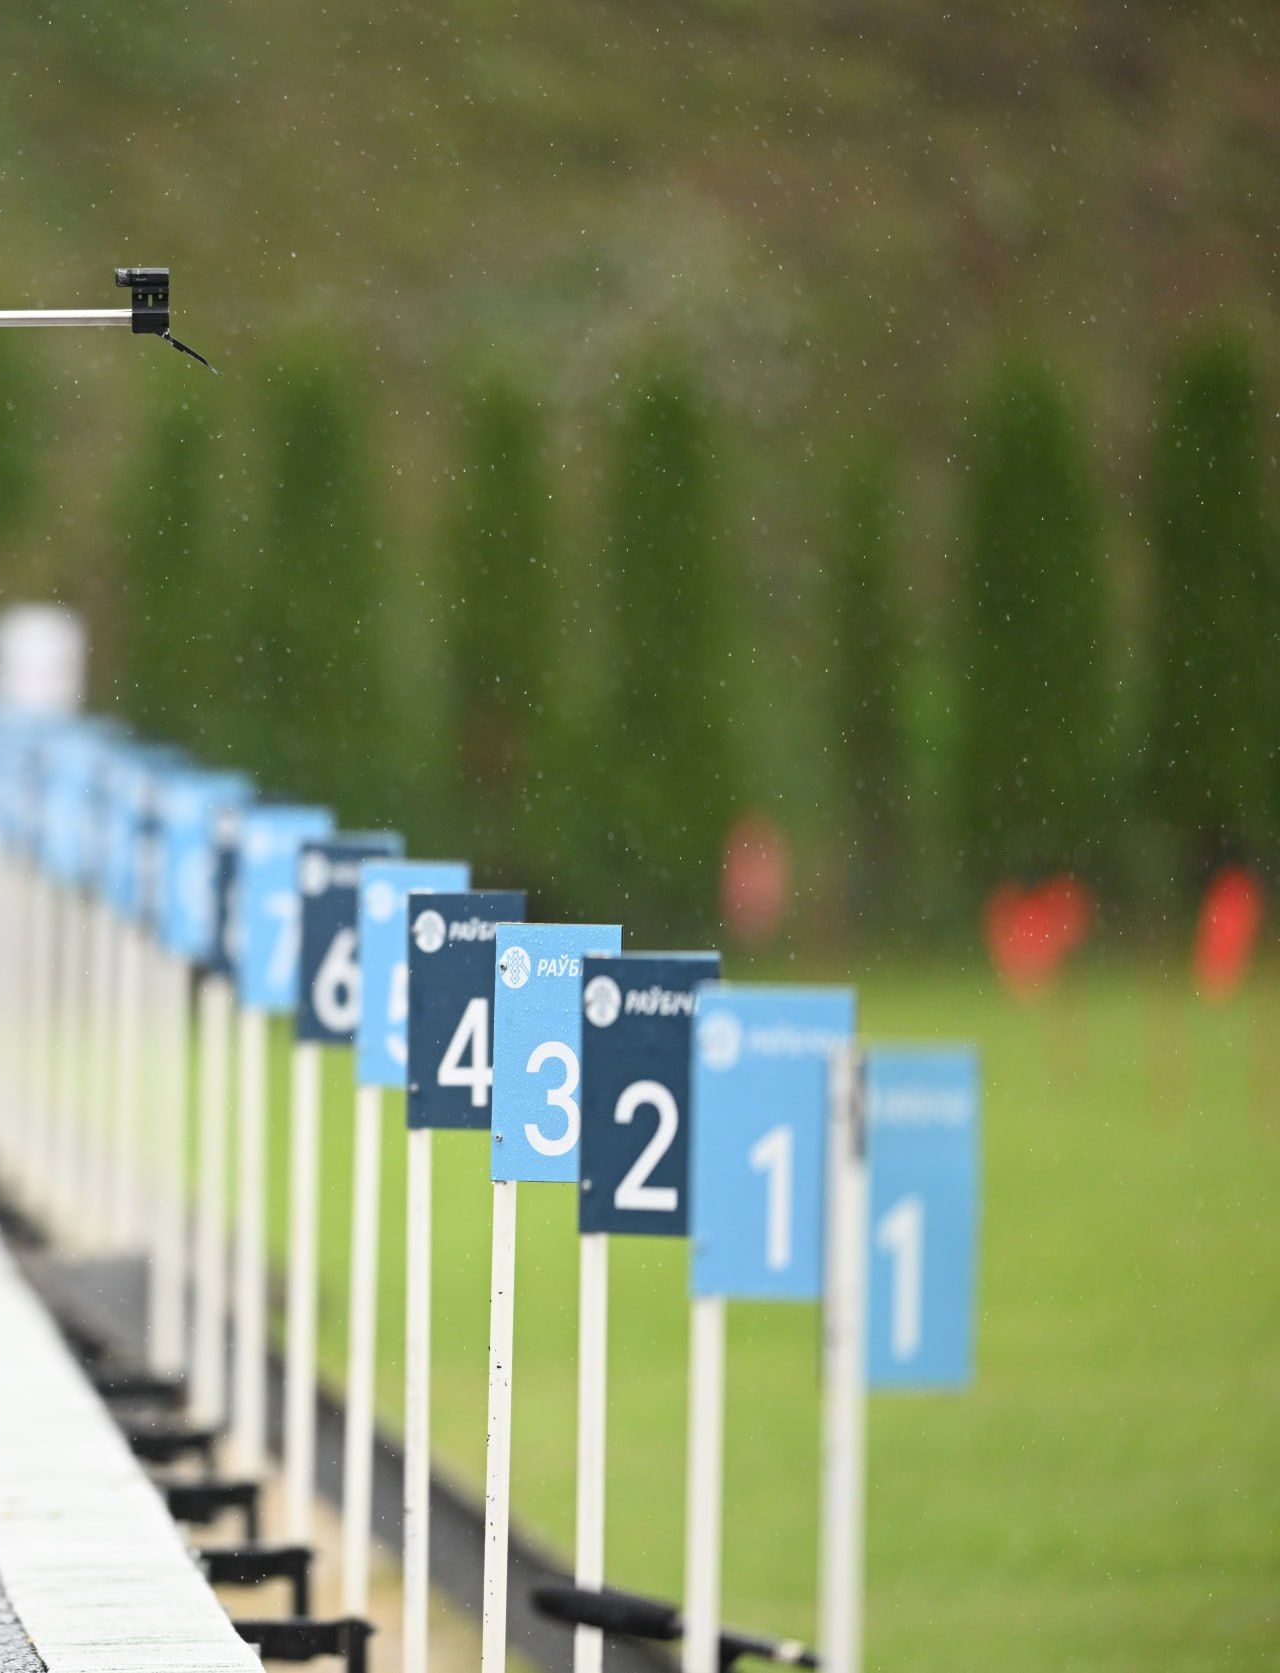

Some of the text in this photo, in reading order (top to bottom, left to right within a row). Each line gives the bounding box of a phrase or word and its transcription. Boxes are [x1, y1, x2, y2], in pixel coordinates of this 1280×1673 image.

[312, 927, 363, 1032] 6
[437, 997, 494, 1107] 4
[524, 1041, 581, 1156] 3
[614, 1080, 679, 1211] 2
[749, 1124, 794, 1272] 1
[876, 1195, 925, 1363] 1
